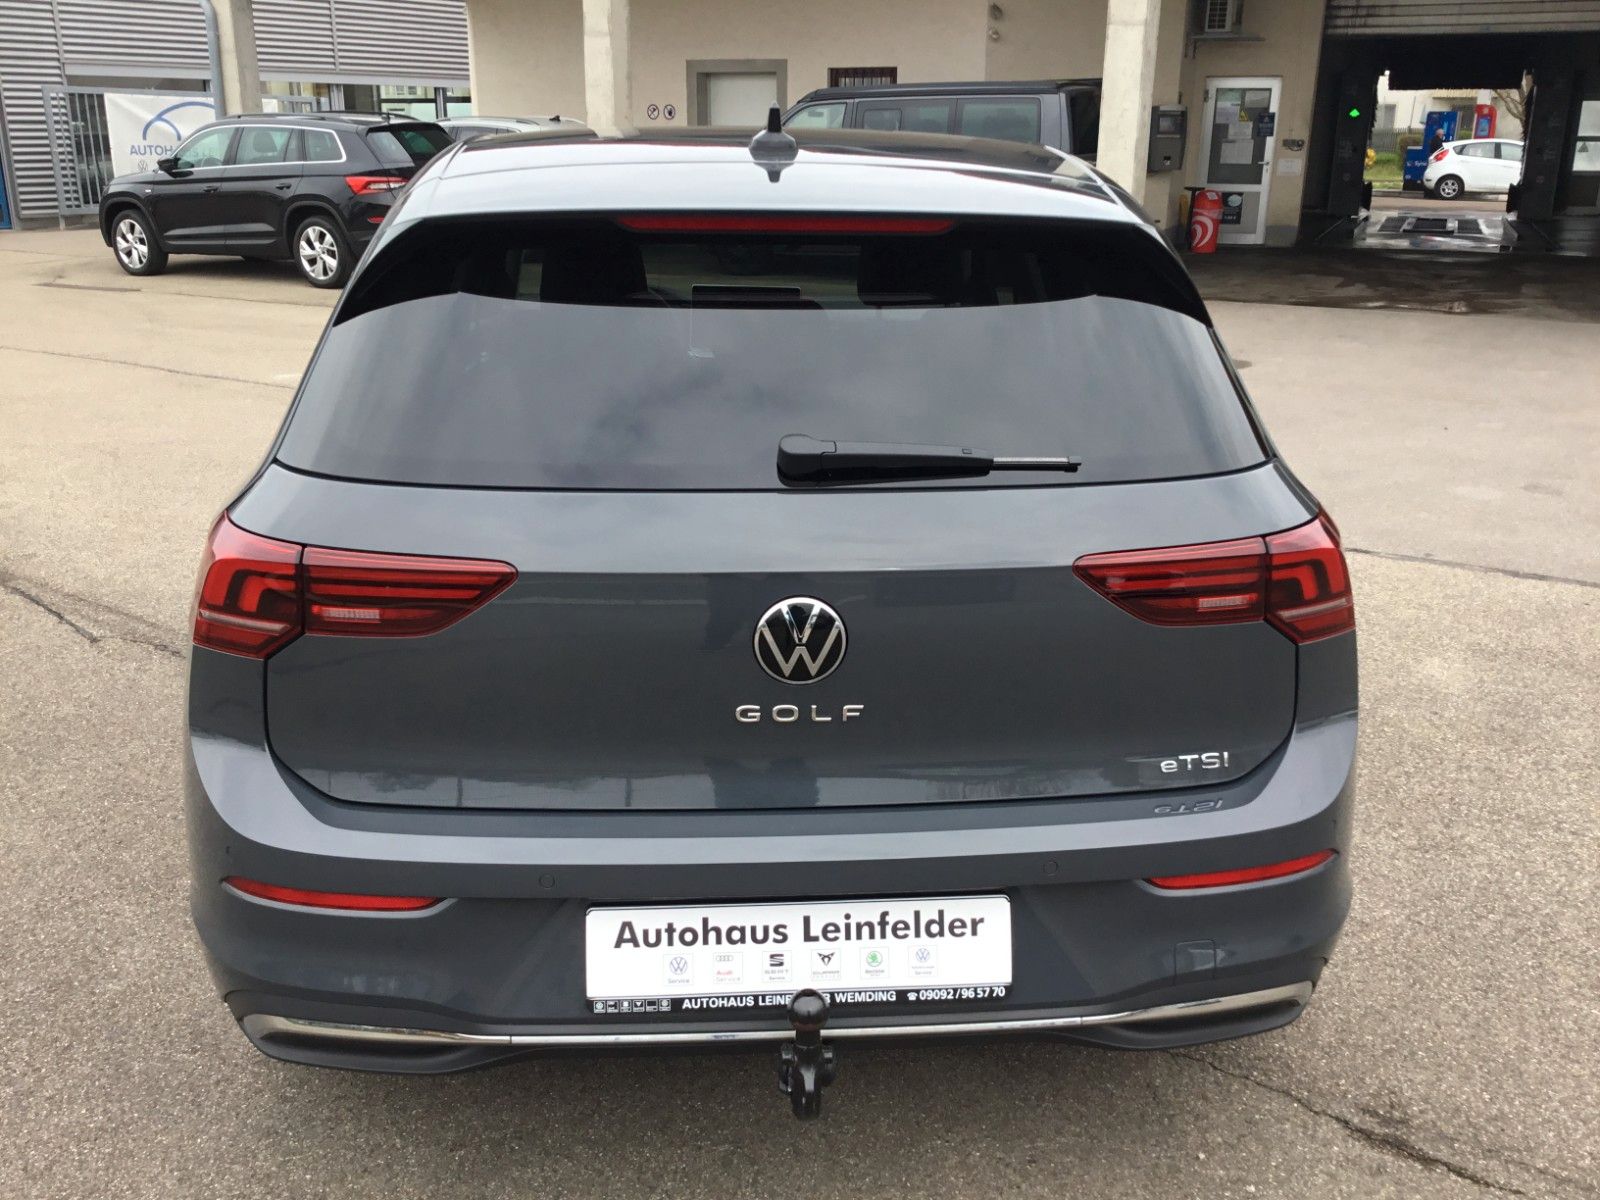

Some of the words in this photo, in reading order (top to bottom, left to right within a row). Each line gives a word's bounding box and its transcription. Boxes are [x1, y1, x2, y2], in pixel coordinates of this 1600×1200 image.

[130, 145, 173, 156] AUTOH
[735, 704, 865, 723] GOLF
[1160, 751, 1229, 773] eTSI
[614, 917, 789, 949] Autohaus
[803, 909, 985, 943] Leinfelder
[682, 996, 755, 1010] AUTOHAUS
[758, 993, 831, 1007] LEINFR
[835, 990, 897, 1004] WEMDING
